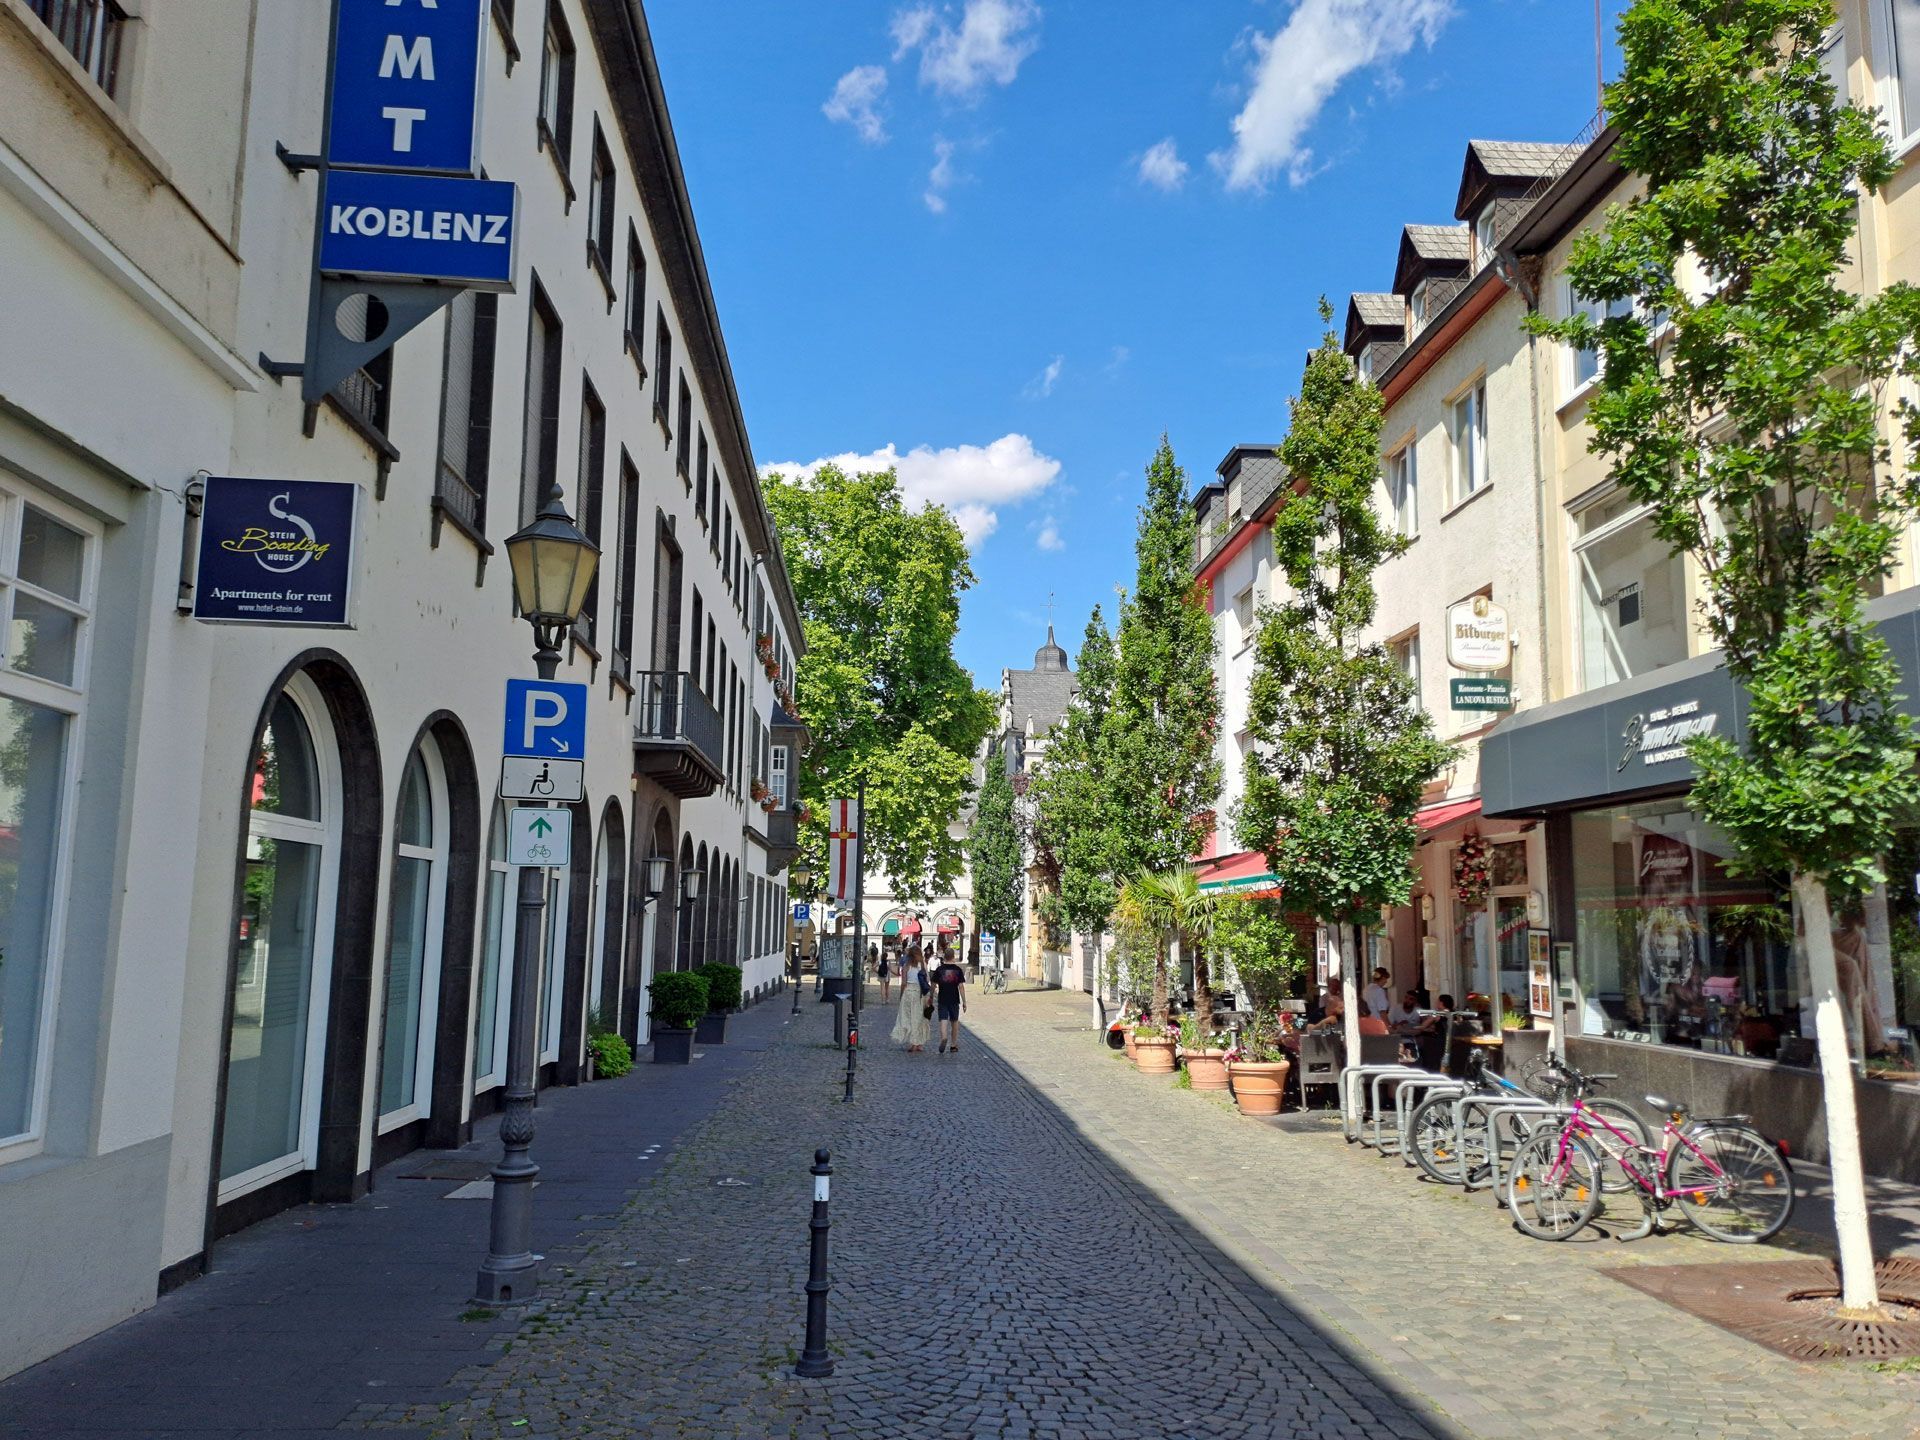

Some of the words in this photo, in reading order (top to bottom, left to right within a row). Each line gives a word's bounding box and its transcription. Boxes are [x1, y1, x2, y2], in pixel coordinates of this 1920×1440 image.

[379, 0, 438, 152] MT
[330, 205, 509, 244] KOBLENZ
[269, 531, 296, 539] STEIN
[221, 528, 331, 561] Boarding
[267, 553, 295, 562] HOUSE
[211, 587, 282, 600] Apartments
[286, 590, 304, 601] for
[307, 593, 332, 602] rent
[237, 604, 303, 614] www.hotel-stein.de
[1455, 623, 1506, 642] Bitburger
[1455, 696, 1465, 704] LA
[1465, 696, 1485, 704] NUOVA
[1486, 696, 1509, 704] RUSTICA
[523, 690, 567, 748] P
[797, 905, 806, 918] P
